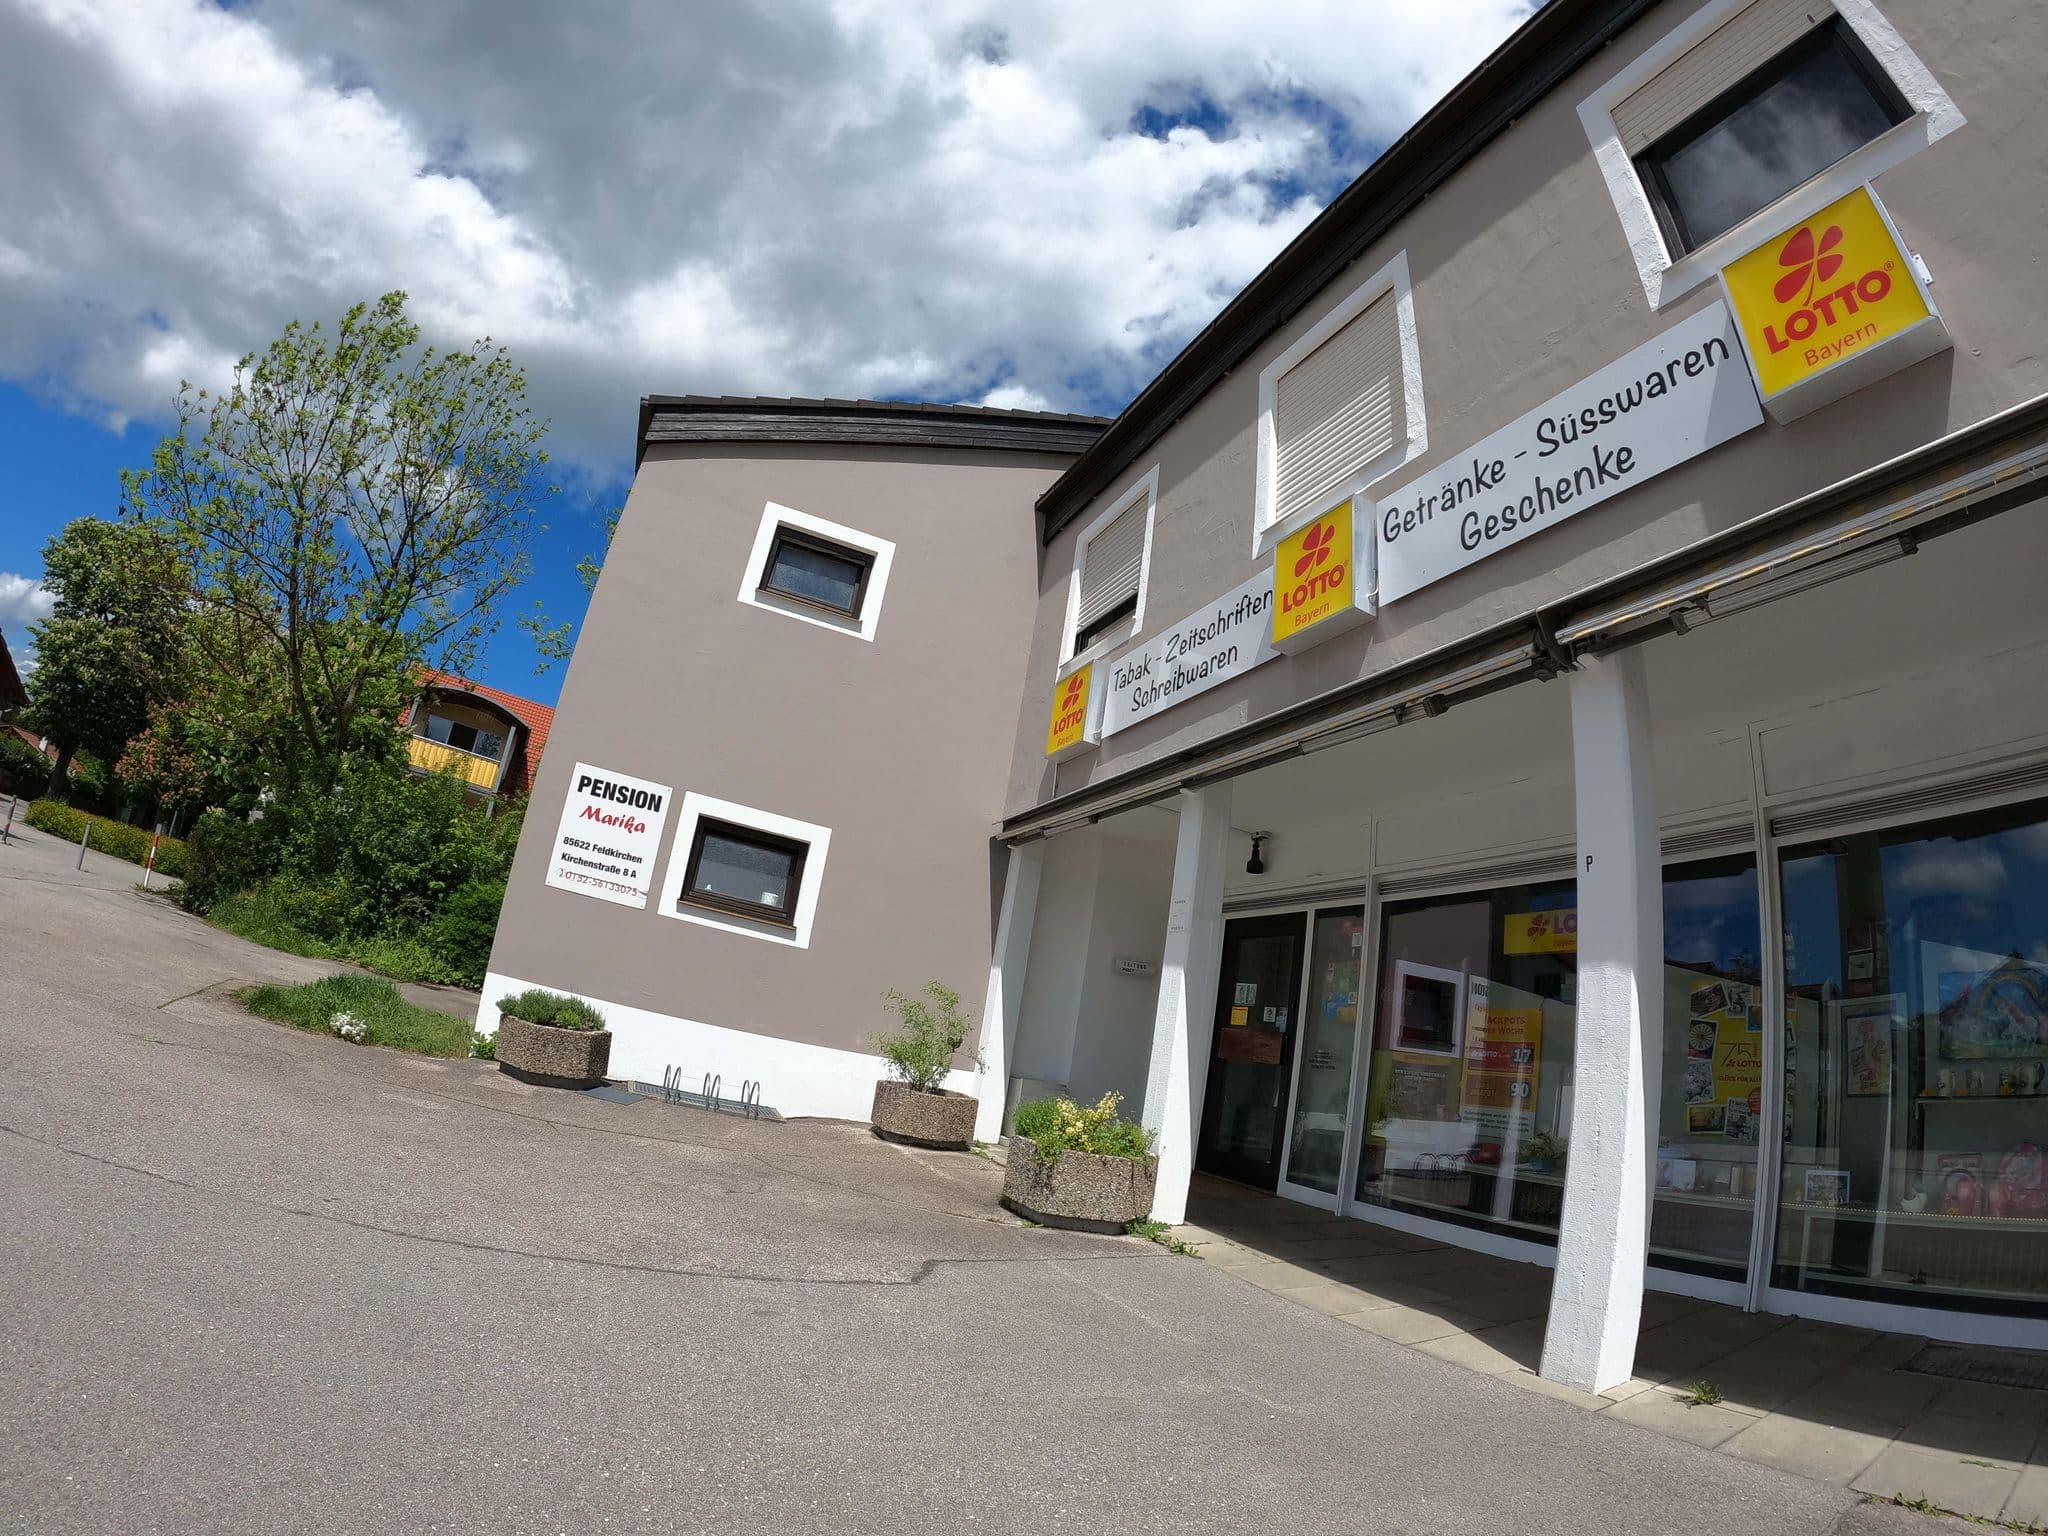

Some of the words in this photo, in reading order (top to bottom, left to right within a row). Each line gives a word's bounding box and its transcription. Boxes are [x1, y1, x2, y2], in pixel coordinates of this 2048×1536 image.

[1803, 322, 1878, 367] Bayern
[1383, 457, 1506, 543] Getränke
[1536, 337, 1730, 458] Süsswaren
[1460, 444, 1636, 551] Geschenke
[1295, 602, 1330, 627] Bayern
[1114, 656, 1151, 692] Tabak
[1165, 588, 1273, 664] Zeitschriften
[1131, 645, 1238, 712] Schreibwaren
[1053, 708, 1084, 736] LOTTO
[577, 775, 663, 813] PENSION
[579, 805, 646, 834] Marika
[561, 852, 621, 875] Kirchenstraße
[623, 868, 629, 877] 8
[630, 870, 637, 878] A
[563, 836, 591, 851] 85622
[592, 844, 643, 864] Feldkirchen
[1586, 855, 1593, 872] P
